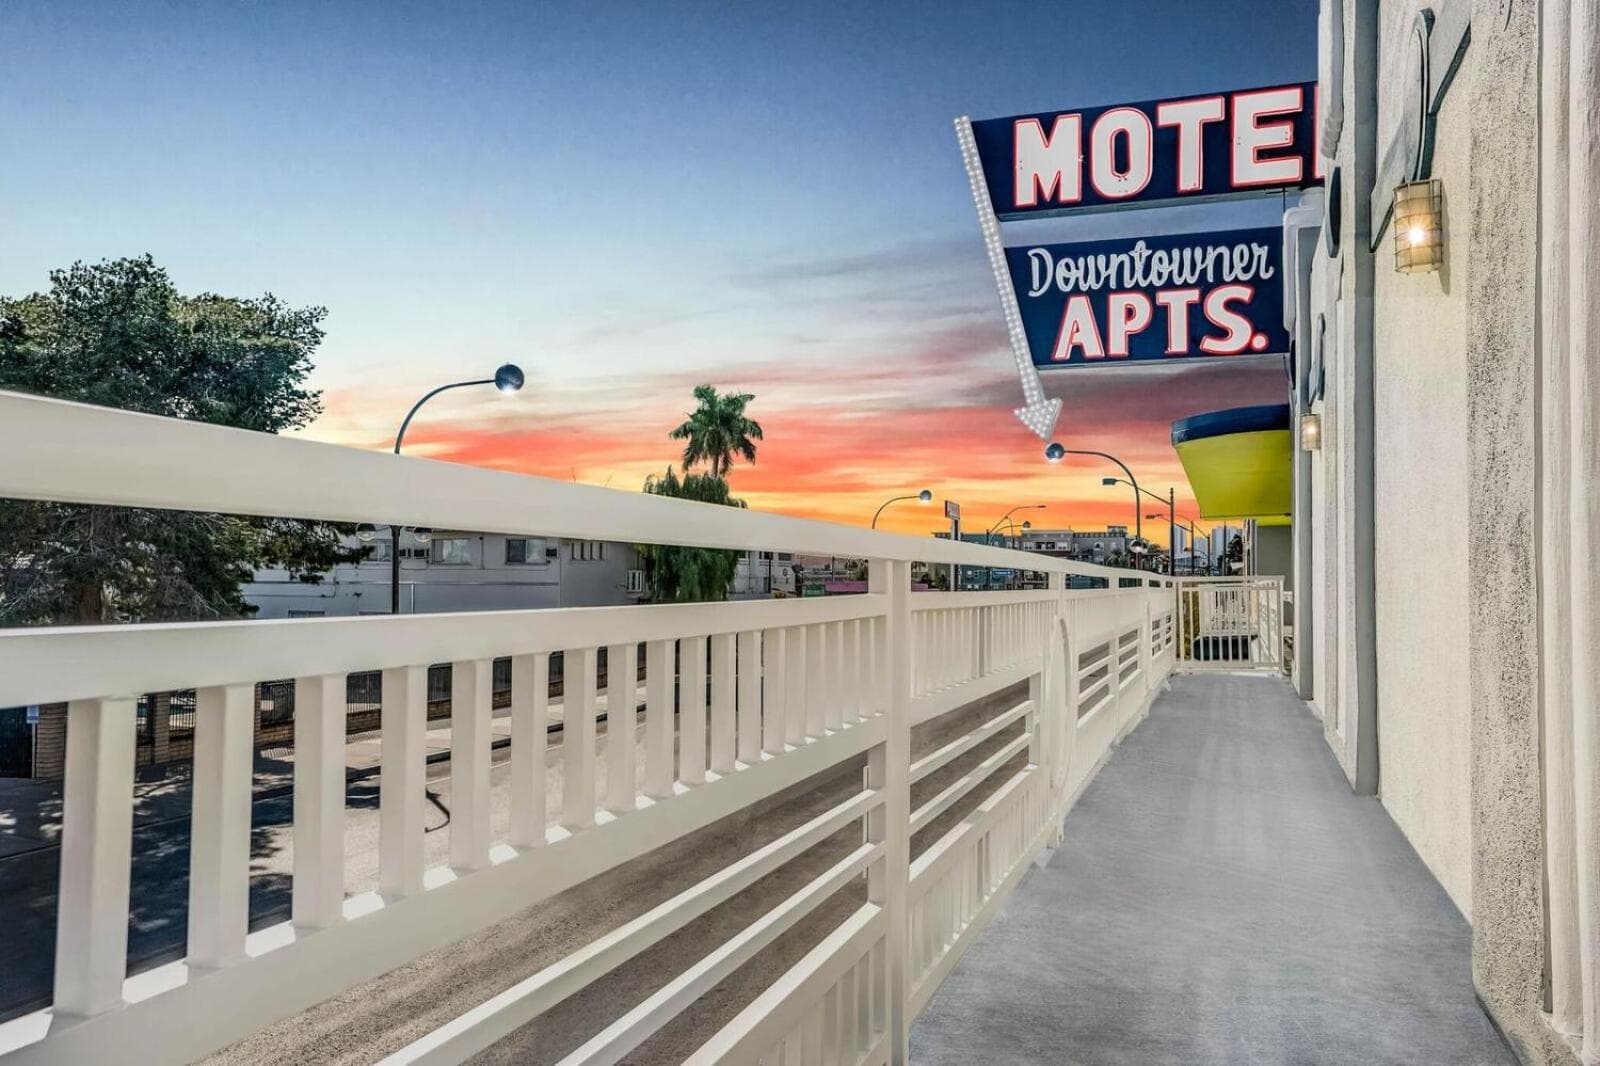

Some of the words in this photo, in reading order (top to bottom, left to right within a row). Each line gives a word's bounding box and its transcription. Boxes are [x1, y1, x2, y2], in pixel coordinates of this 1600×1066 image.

[1013, 85, 1324, 207] MOTE
[1028, 241, 1274, 297] Downtowner
[1054, 285, 1269, 360] APTS.
